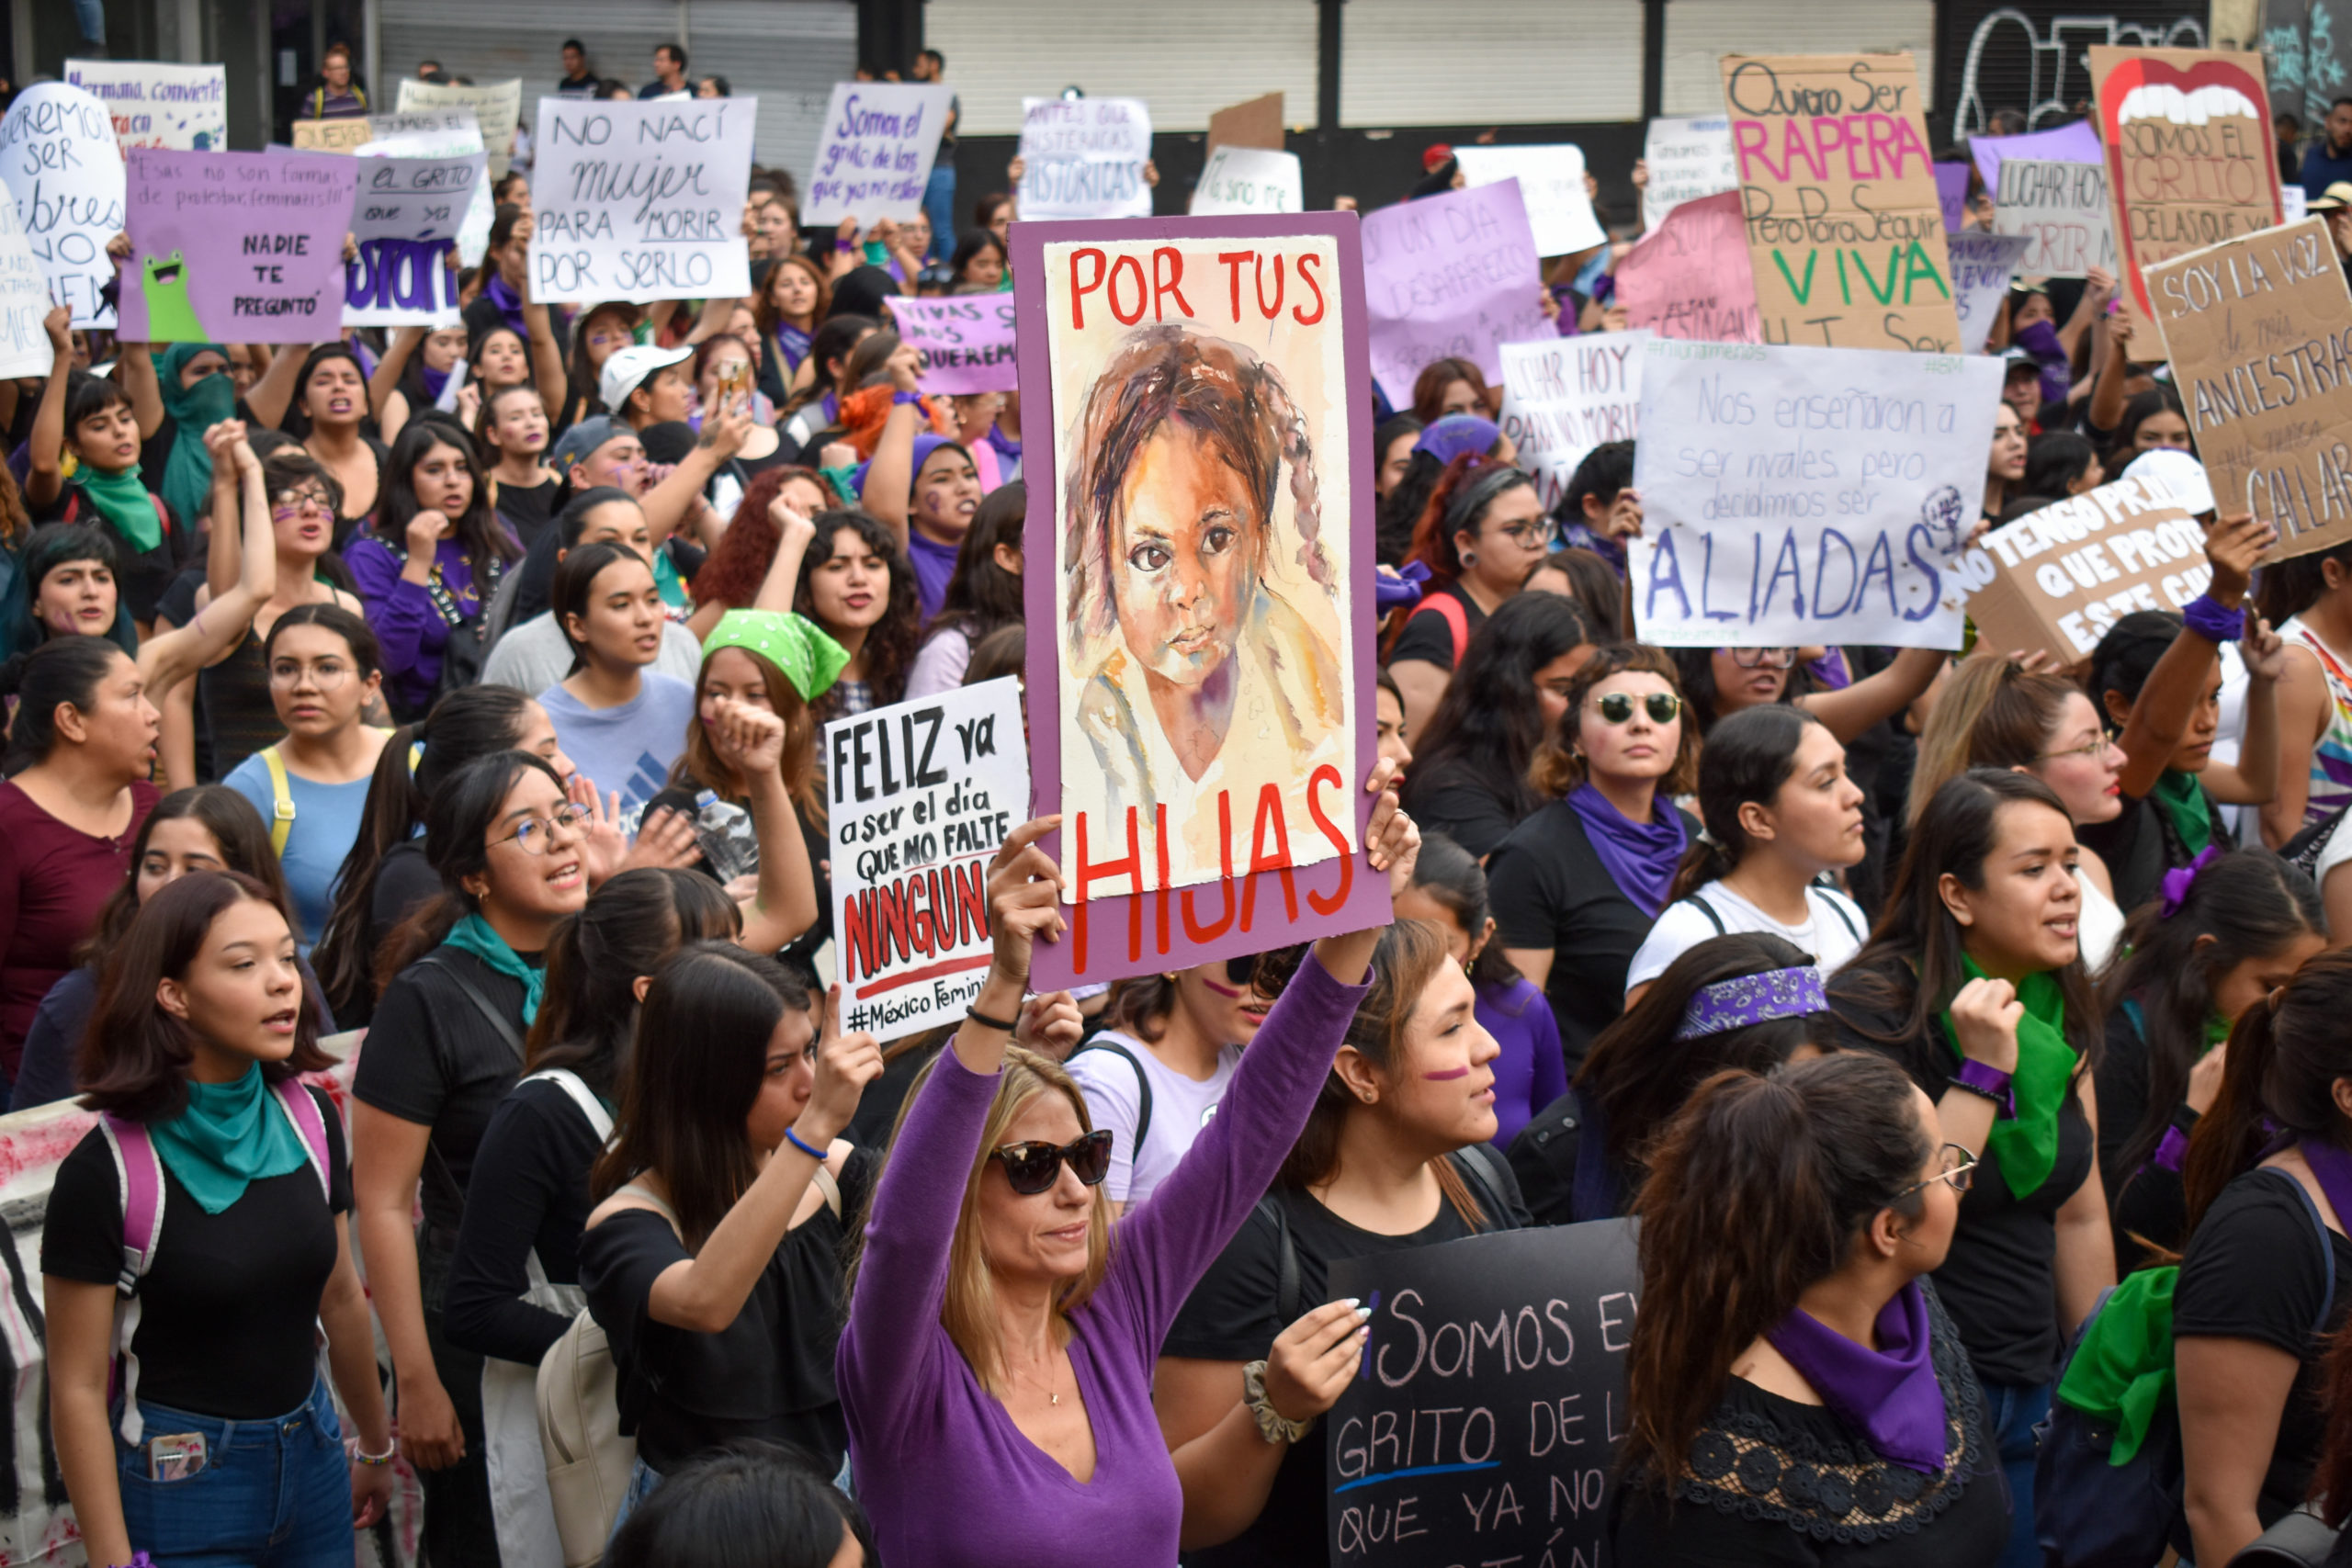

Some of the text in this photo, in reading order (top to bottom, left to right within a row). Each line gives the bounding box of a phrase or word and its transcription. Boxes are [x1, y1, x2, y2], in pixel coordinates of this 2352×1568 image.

[1849, 61, 1909, 114] Ser
[553, 115, 612, 146] NO
[639, 104, 729, 144] NACÍ
[1733, 113, 1937, 182] RAPERA
[2122, 121, 2213, 159] SOMOS
[2221, 123, 2256, 160] EL
[237, 164, 271, 182] son
[413, 164, 473, 189] GRITO
[571, 154, 710, 225] mujer
[2132, 154, 2257, 204] GRITO
[243, 234, 311, 256] NADIE
[537, 208, 726, 245] PARA MORIR
[254, 265, 284, 284] TE
[537, 249, 599, 296] POR
[1069, 246, 1325, 331] POR TUS
[1771, 239, 1951, 307] VIVA
[2163, 231, 2330, 319] SOY LA VOZ
[233, 288, 322, 317] PREGUNTÓ
[1577, 344, 1632, 395] HOY
[1696, 371, 1757, 426] Nos
[1860, 448, 1928, 487] pero
[1702, 481, 1882, 521] decidimos ser
[1645, 522, 1942, 626] ALIADAS
[1940, 547, 1997, 610] NO
[1978, 496, 2107, 569] TENGO
[2034, 543, 2121, 598] QUE
[832, 705, 949, 804] FELIZ
[840, 776, 991, 845] a ser el día
[855, 810, 1011, 886] QUE NO FALTE
[1072, 763, 1353, 976] HIJAS
[843, 854, 998, 985] NINGUN
[1335, 1406, 1496, 1478] GRITO
[1529, 1393, 1586, 1458] DE
[1338, 1495, 1430, 1555] QUE
[1462, 1481, 1525, 1533] YA
[1550, 1468, 1605, 1522] NO
